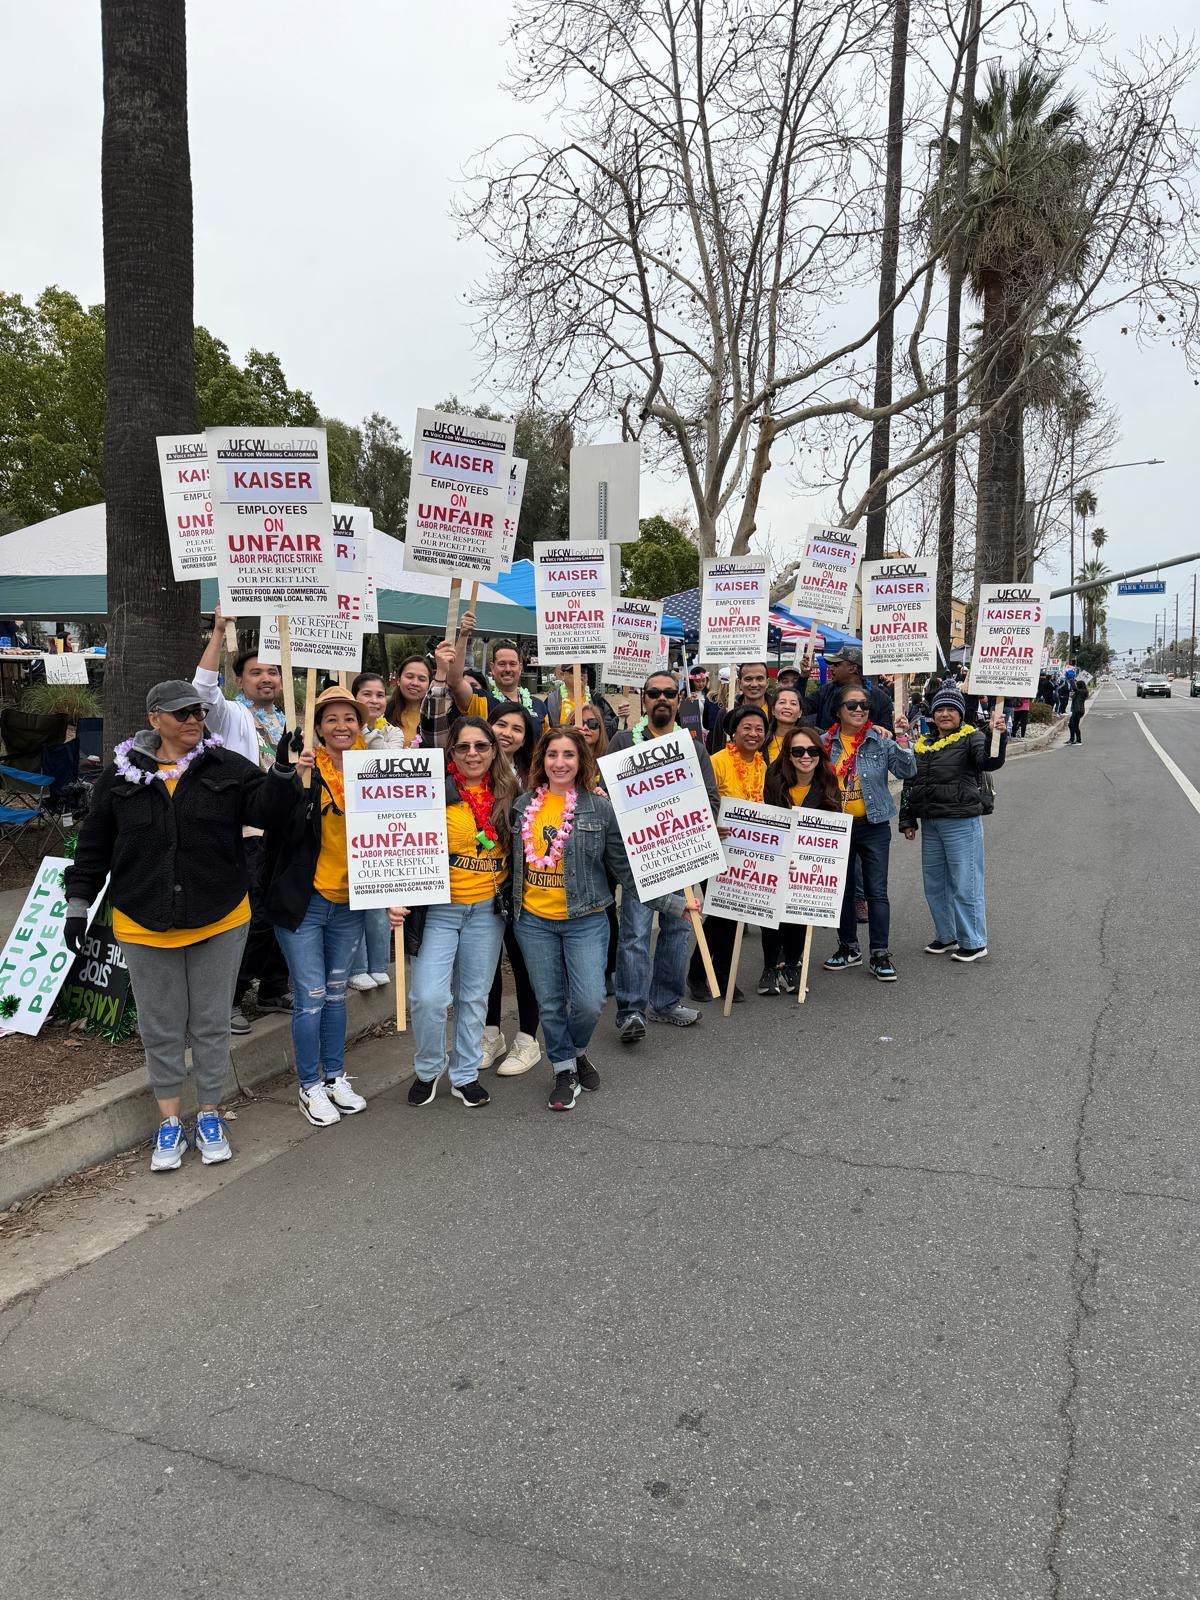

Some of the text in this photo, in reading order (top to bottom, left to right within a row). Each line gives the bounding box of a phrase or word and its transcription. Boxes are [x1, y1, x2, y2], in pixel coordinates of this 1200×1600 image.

[434, 422, 506, 443] UFCW Local 770
[175, 444, 202, 454] UFCW
[229, 440, 317, 451] UFCW Local 770
[431, 451, 493, 473] KAISER
[235, 472, 311, 488] KAISER
[431, 479, 488, 495] EMPLOYEES
[451, 494, 467, 507] ON
[238, 505, 307, 514] EMPLOYEES
[419, 504, 493, 528] UNFAIR
[264, 518, 283, 532] ON
[417, 520, 492, 538] LABOR PRACTICE STRIKE
[423, 531, 486, 545] PLEASE RESPECT
[821, 530, 851, 542] UFCW
[229, 535, 320, 551] UNFAIR
[439, 542, 466, 550] PICKET
[548, 549, 571, 557] UFCW
[813, 545, 850, 558] KAISER
[230, 554, 323, 563] LABOR PRACTICE STRIKE
[812, 562, 846, 573] EMPLOYEES
[881, 564, 916, 576] UFCW
[549, 570, 597, 581] KAISER
[822, 570, 833, 579] ON
[716, 581, 758, 591] KAISER
[803, 576, 848, 591] UNFAIR
[876, 583, 923, 594] KAISER
[997, 589, 1031, 598] UFCW
[568, 600, 580, 608] ON
[624, 602, 650, 613] UFCW
[877, 603, 921, 612] EMPLOYEES
[545, 610, 603, 622] UNFAIR
[708, 616, 760, 626] UNFAIR
[892, 612, 905, 622] ON
[987, 610, 1031, 620] KAISER
[618, 617, 652, 628] KAISER
[870, 622, 927, 634] UNFAIR
[618, 631, 649, 640] EMPLOYEES
[1001, 636, 1014, 645] ON
[980, 646, 1033, 658] UNFAIR
[629, 741, 680, 770] UFCW
[376, 758, 429, 772] UFCW
[626, 768, 686, 797] KAISER
[362, 785, 427, 799] KAISER
[644, 796, 680, 813] EMPLOYEES
[656, 809, 674, 822] ON
[733, 807, 758, 818] UFCW
[802, 815, 822, 824] UFCW
[388, 822, 406, 832] ON
[632, 811, 702, 844] UNFAIR
[360, 832, 437, 848] UNFAIR
[636, 824, 706, 854] LABOR PRACTICE STRIKE
[728, 827, 779, 845] KAISER
[798, 835, 838, 849] KAISER
[384, 848, 415, 856] PRACTICE
[642, 834, 704, 862] PLEASE RESPECT
[640, 841, 712, 872] OUR PICKET LINE
[729, 848, 774, 861] EMPLOYEES
[799, 854, 835, 864] EMPLOYEES
[362, 857, 433, 868] PLEASE RESPECT
[454, 856, 496, 871] 770 STRONG
[640, 874, 659, 884] UNITED
[659, 868, 674, 878] FOOD
[687, 852, 719, 868] COMMERCIAL
[743, 859, 756, 870] ON
[812, 864, 822, 873] ON
[358, 866, 440, 878] OUR PICKET LINE
[642, 876, 666, 888] WORKERS
[667, 868, 684, 878] UNION
[684, 864, 700, 872] LOCAL
[790, 872, 837, 887] UNFAIR
[19, 900, 68, 988] OVER
[79, 960, 112, 988] STOP
